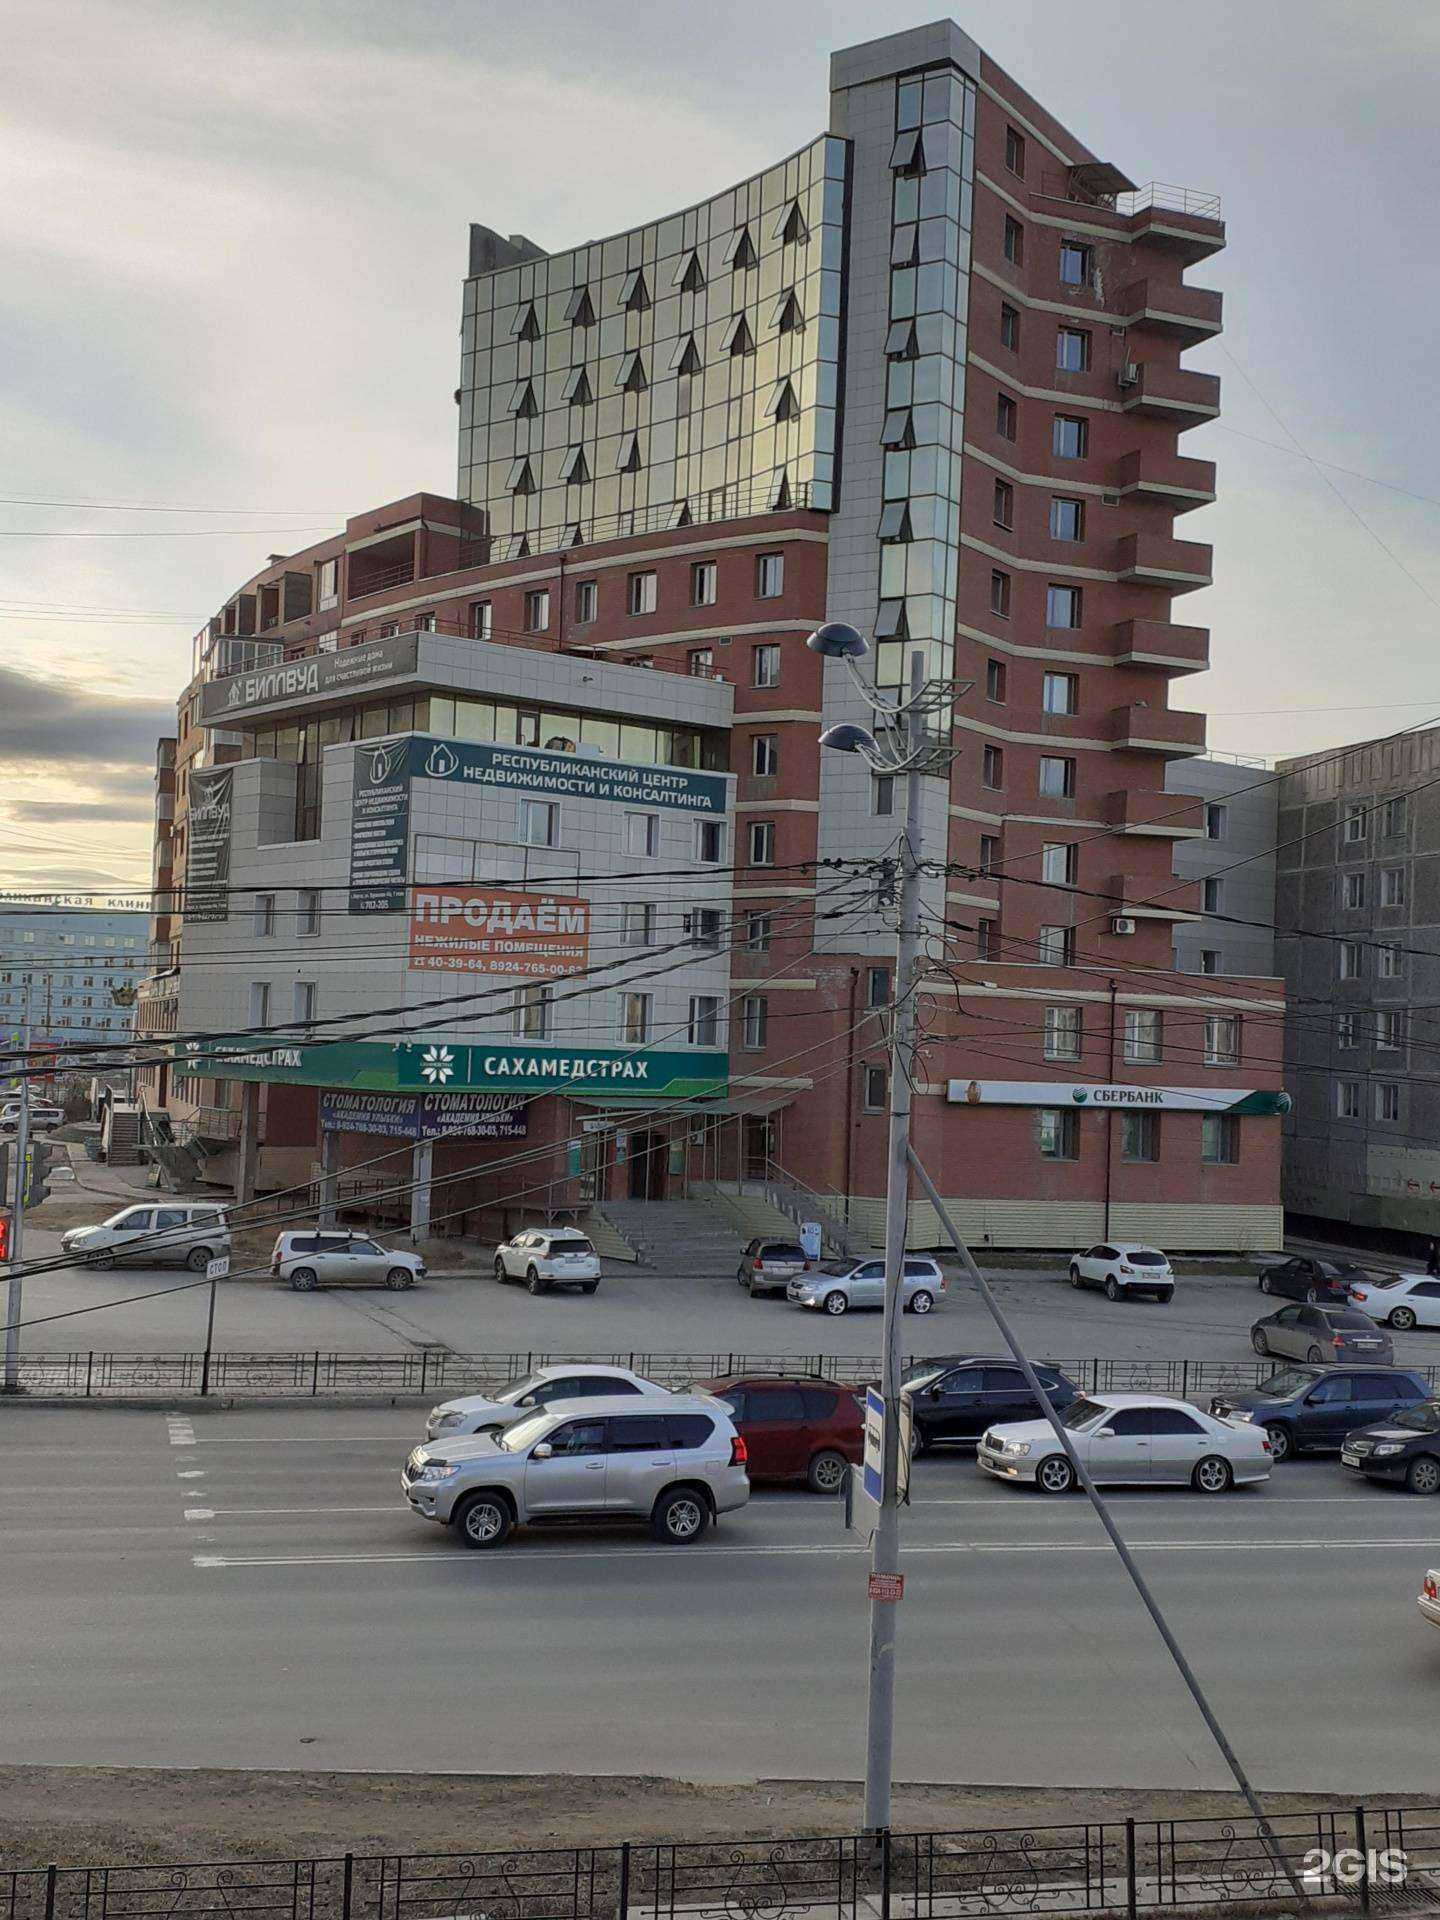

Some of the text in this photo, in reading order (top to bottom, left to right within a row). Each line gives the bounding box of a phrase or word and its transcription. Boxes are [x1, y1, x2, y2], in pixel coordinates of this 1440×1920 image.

[245, 664, 318, 702] БИЛЛВУД
[492, 753, 688, 790] РЕСПУБЛИКАНСКИЙ ЦЕНТР
[463, 765, 712, 808] НЕДВИЖИМОСТИ И КОНСАЛТИНГА
[415, 894, 585, 935] ПРОДАЁМ
[415, 935, 584, 957] НЕЖИЛЫЕ ПОМЕЩЕНИЯ
[428, 957, 486, 971] 40-39-64,
[484, 1056, 648, 1079] САХАМЕДСТРАХ
[323, 1093, 416, 1114] СТОМАТОЛОГИЯ
[424, 1093, 526, 1111] СТОМАТОЛОГИЯ
[1093, 1089, 1163, 1103] СБЕРБАНК
[422, 1125, 441, 1136] Тел.:
